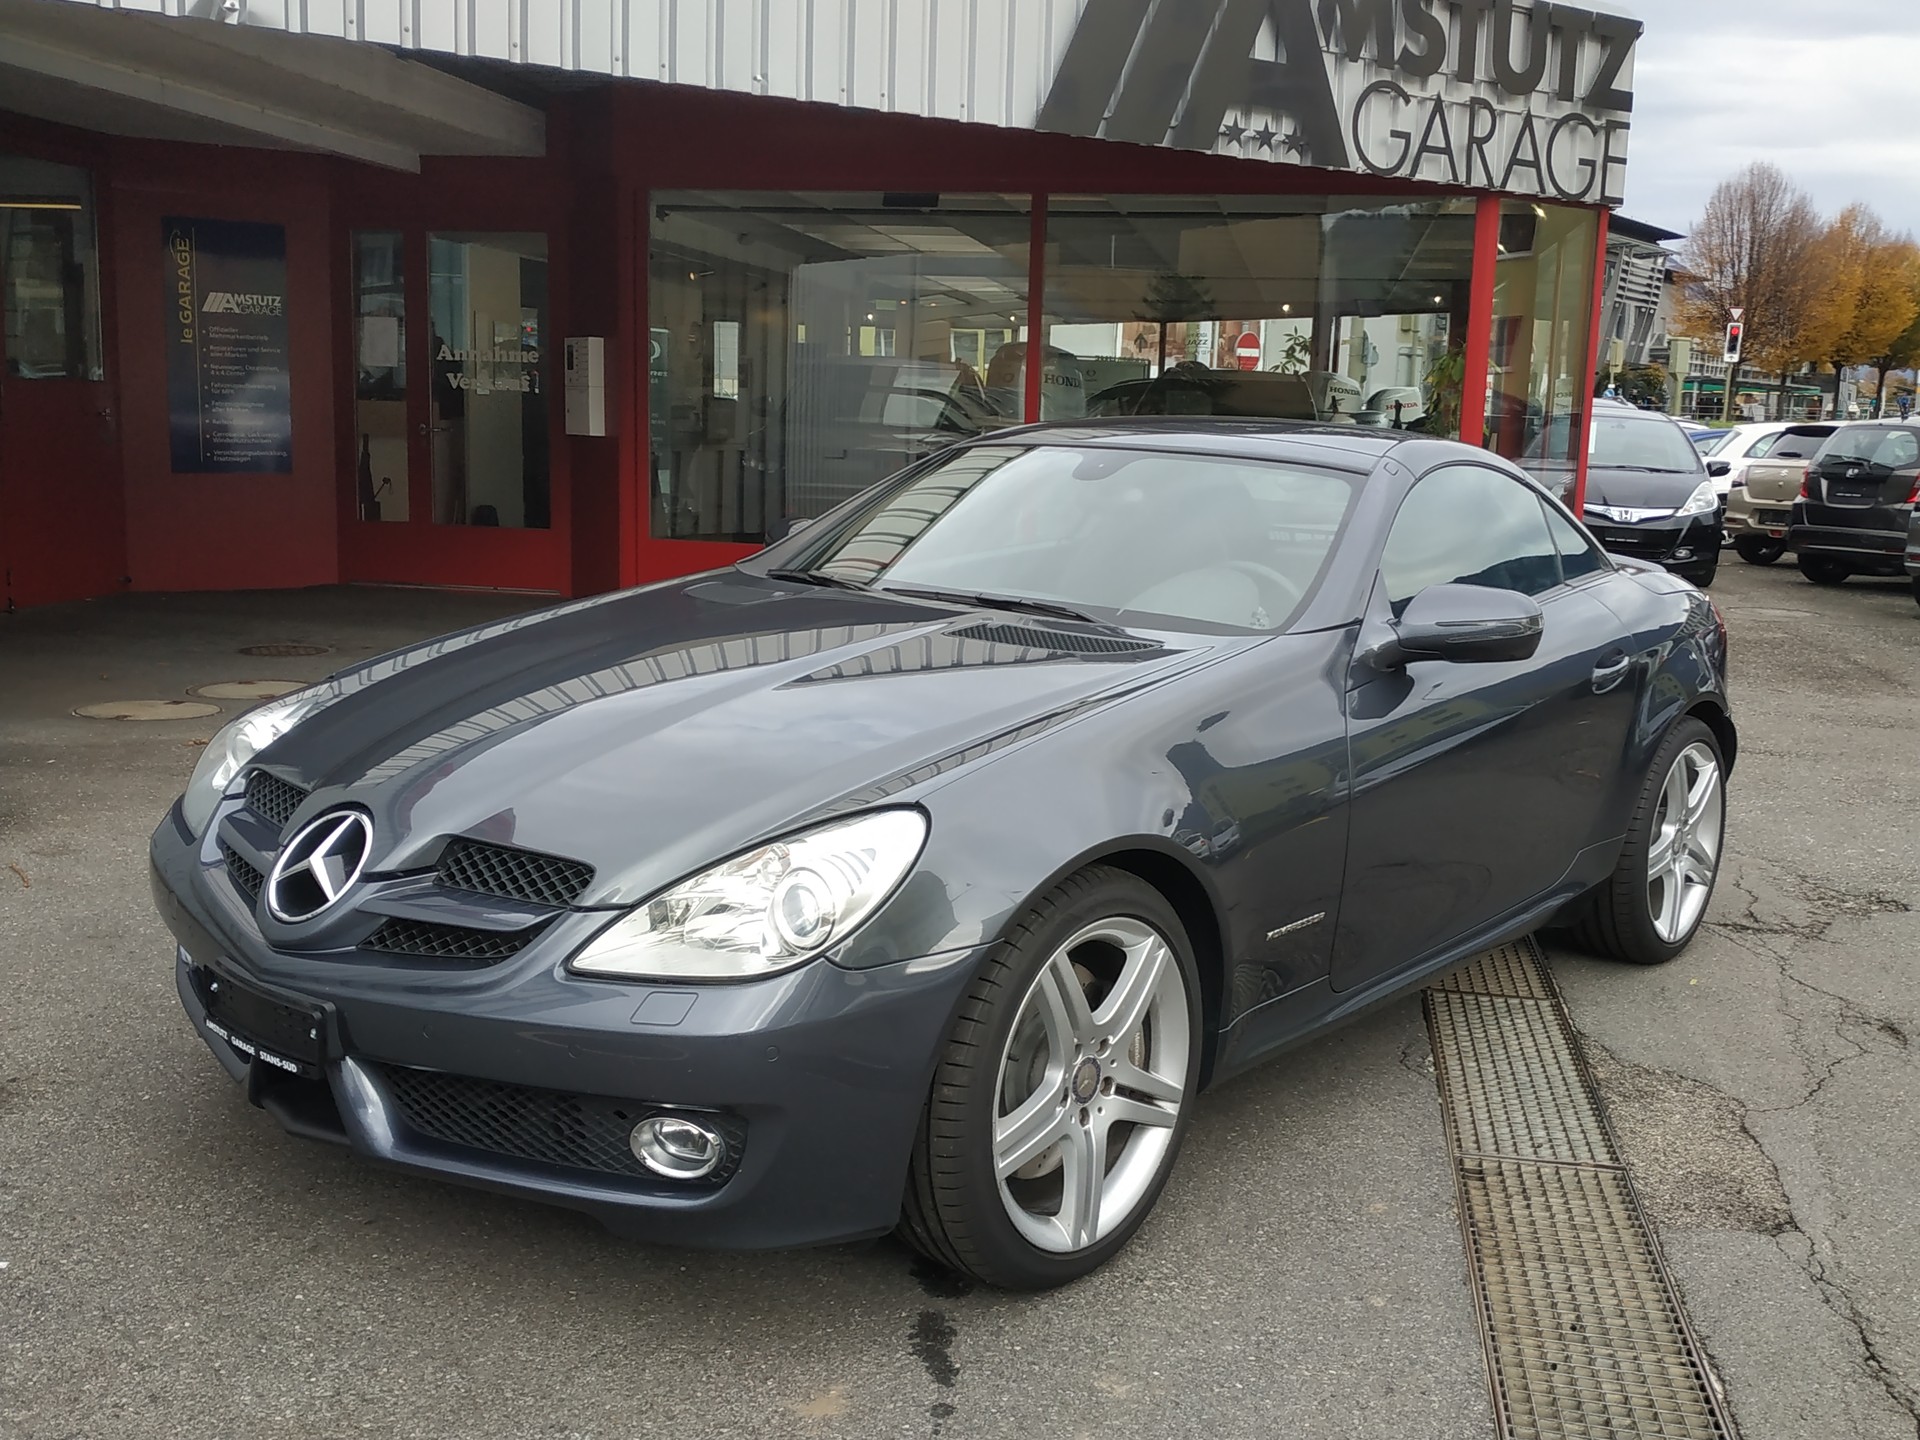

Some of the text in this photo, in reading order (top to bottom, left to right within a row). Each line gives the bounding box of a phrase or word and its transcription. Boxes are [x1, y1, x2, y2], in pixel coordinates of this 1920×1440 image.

[1163, 0, 1645, 169] AMSTUTZ
[1352, 79, 1631, 206] GARAGE
[176, 238, 193, 344] le GARAGE
[217, 291, 282, 314] AMSTUTZ
[239, 304, 282, 316] GARAGE
[436, 344, 539, 364] Annahme
[1044, 373, 1081, 388] HOND
[1329, 386, 1361, 397] HONDA
[1385, 402, 1419, 411] HNDA
